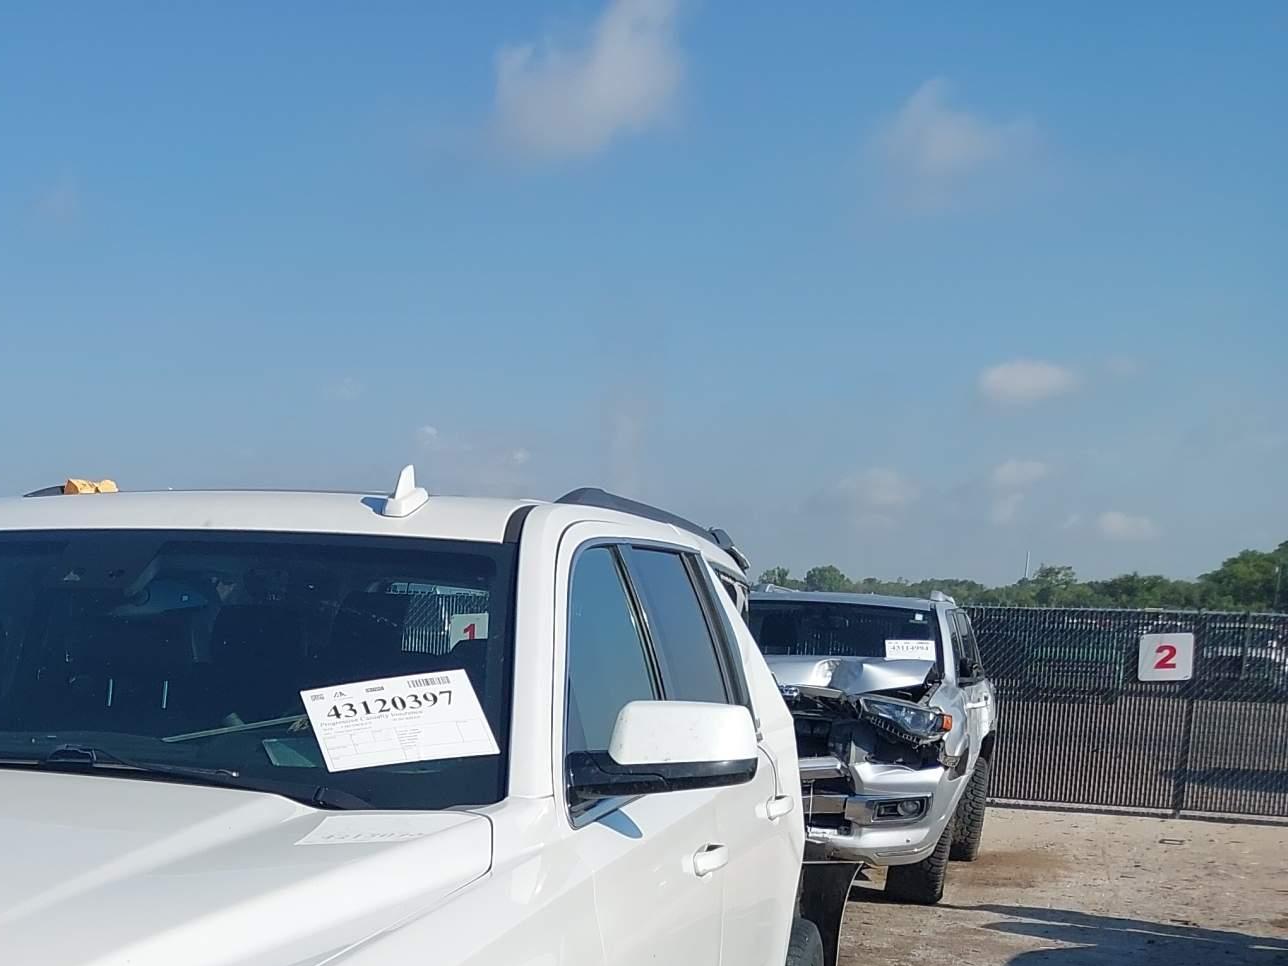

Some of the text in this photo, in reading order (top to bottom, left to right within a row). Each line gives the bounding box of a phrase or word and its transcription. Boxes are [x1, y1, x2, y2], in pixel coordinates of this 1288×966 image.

[463, 623, 476, 640] 1
[1153, 644, 1177, 669] 2
[327, 690, 452, 719] 43120397
